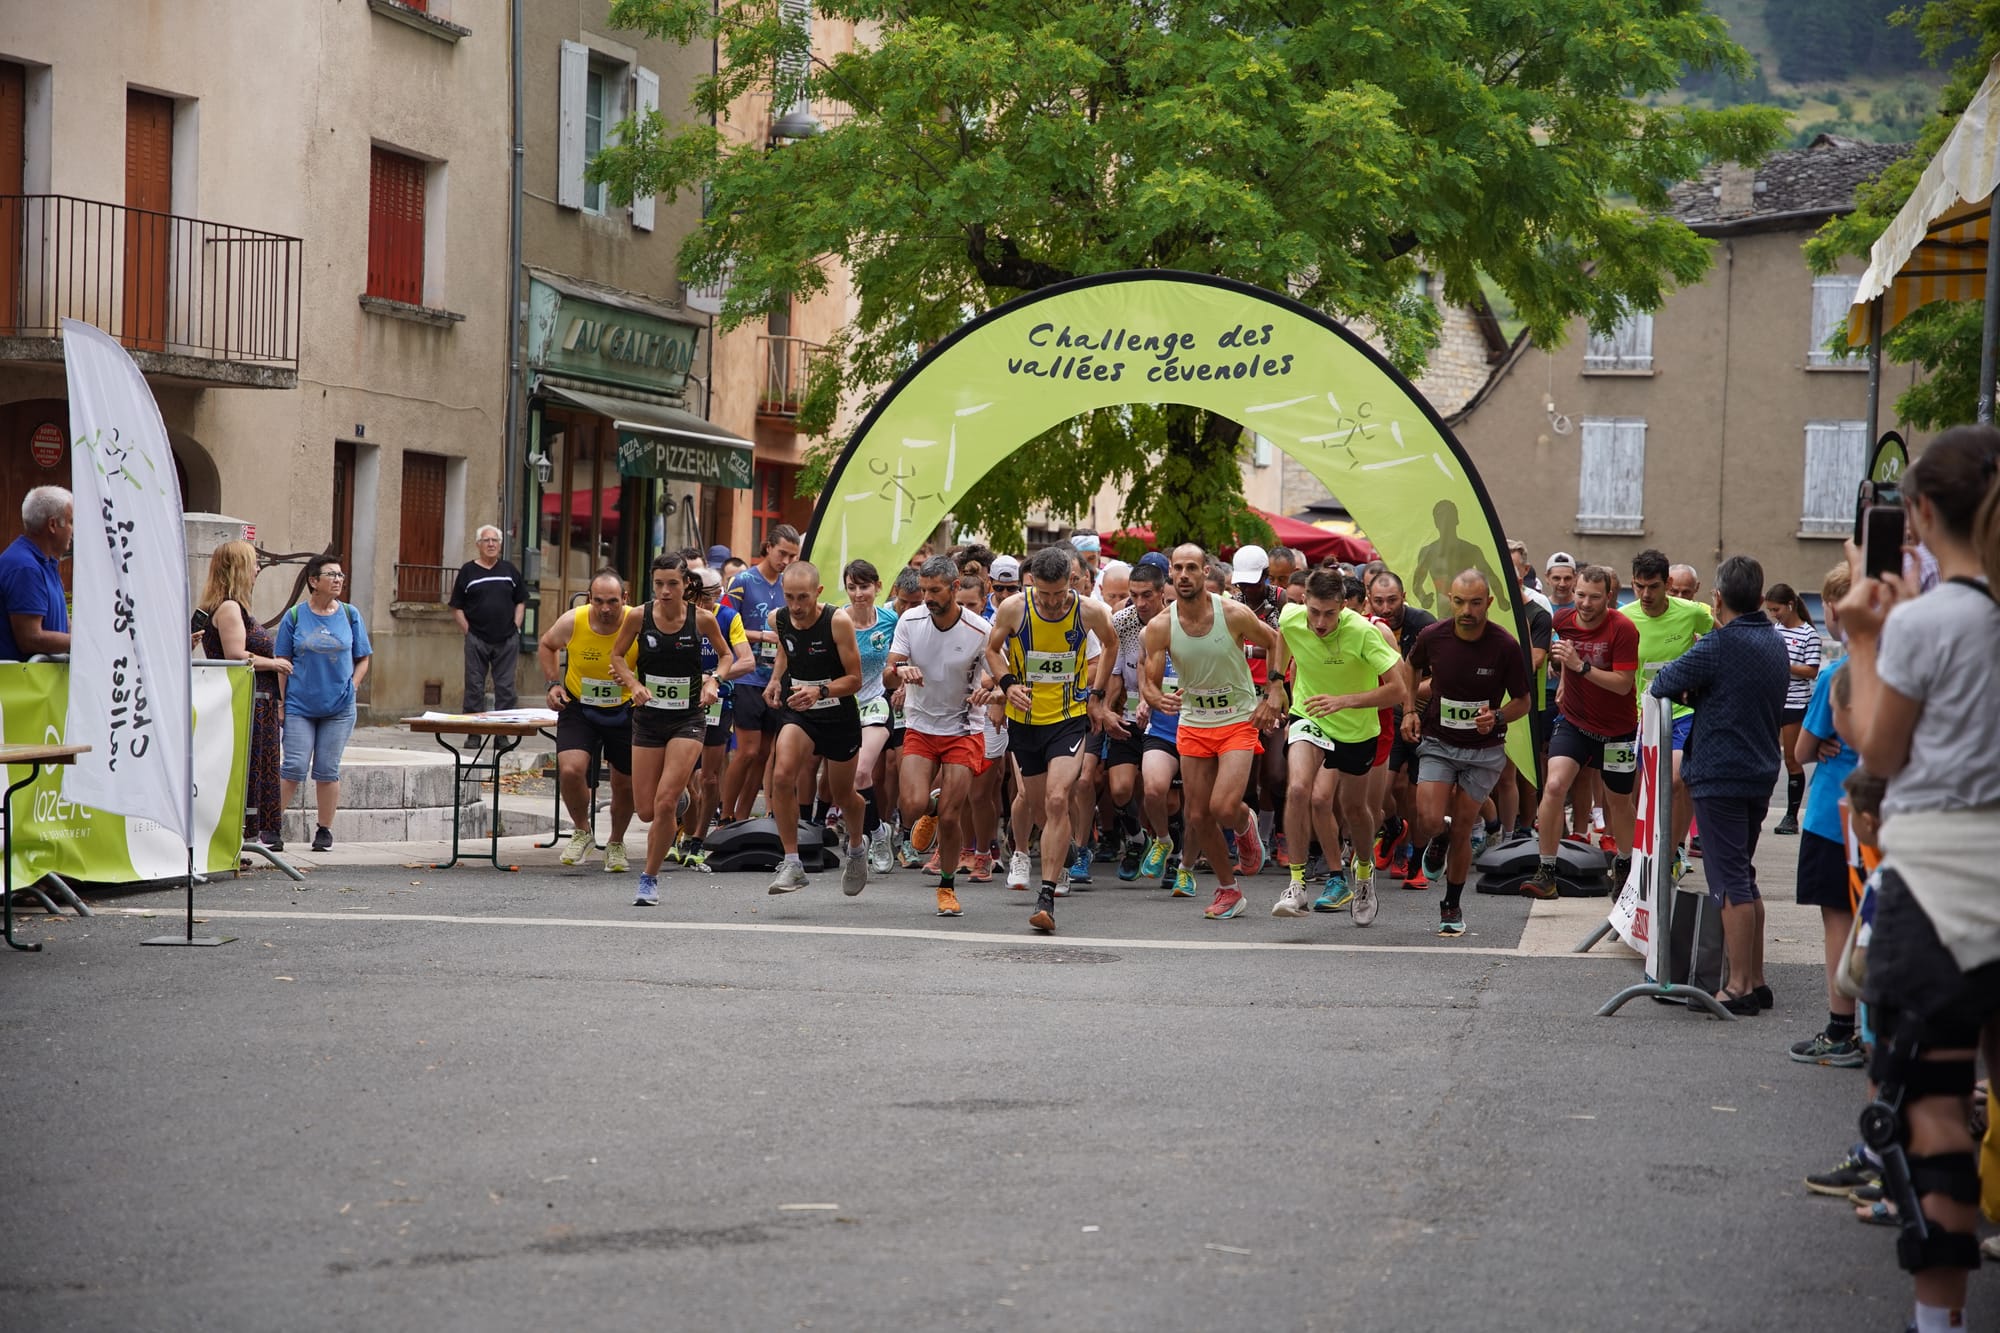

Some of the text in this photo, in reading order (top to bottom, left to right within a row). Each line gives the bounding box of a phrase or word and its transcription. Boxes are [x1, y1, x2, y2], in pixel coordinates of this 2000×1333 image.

[569, 319, 604, 353] AU
[1028, 323, 1274, 360] Challenge des
[1008, 354, 1295, 382] vallées cévenoles
[618, 437, 640, 457] PIZZA
[655, 443, 720, 478] PIZZERIA
[730, 450, 750, 475] PIZZA
[1039, 660, 1063, 673] 48
[591, 686, 611, 697] 15
[656, 685, 678, 699] 56
[1195, 694, 1229, 709] 115
[1300, 724, 1323, 738] 43
[1616, 750, 1636, 763] 35
